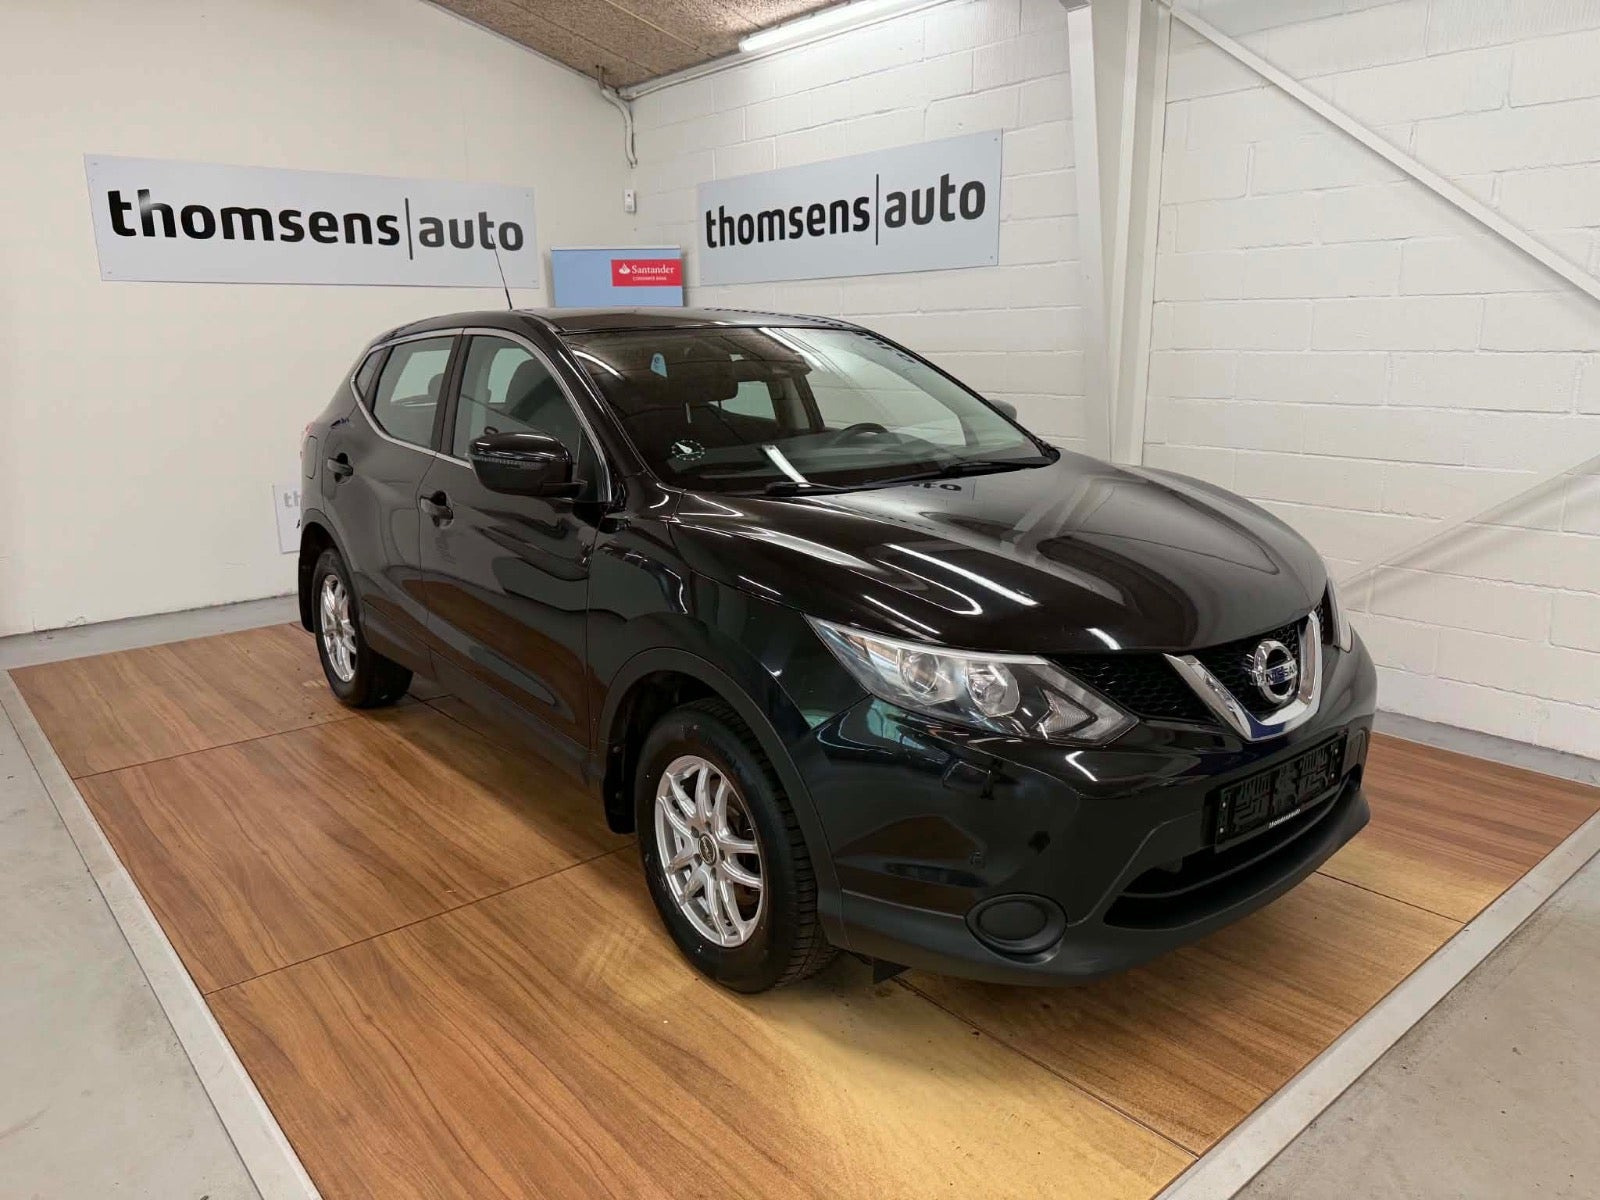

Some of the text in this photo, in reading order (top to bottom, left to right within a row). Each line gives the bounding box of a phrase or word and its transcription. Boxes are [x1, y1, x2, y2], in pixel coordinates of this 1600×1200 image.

[107, 188, 524, 251] thomsens auto
[706, 173, 986, 248] thomsens auto
[631, 264, 675, 275] Santander
[1265, 662, 1297, 684] NISSAN
